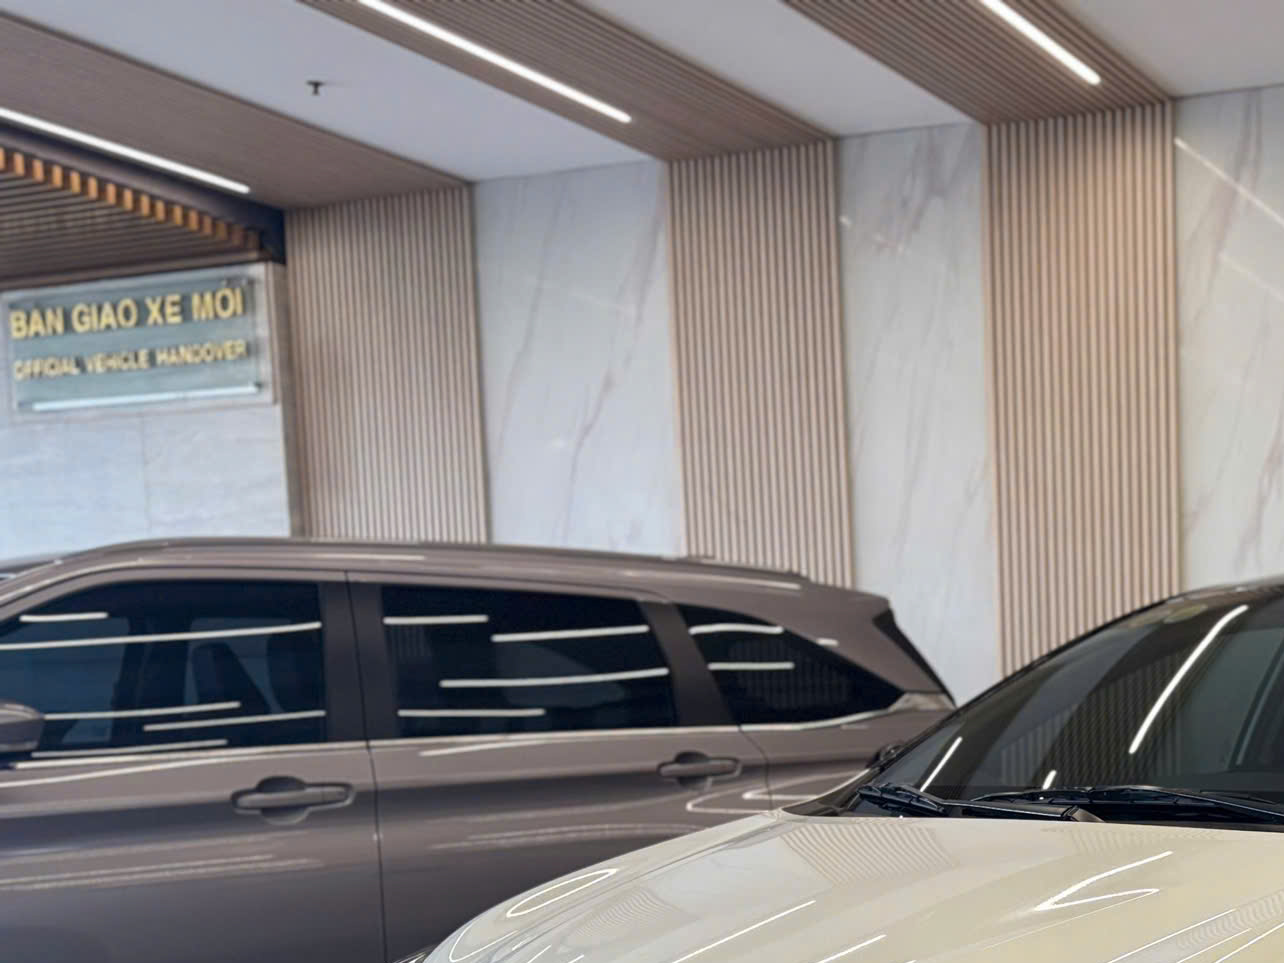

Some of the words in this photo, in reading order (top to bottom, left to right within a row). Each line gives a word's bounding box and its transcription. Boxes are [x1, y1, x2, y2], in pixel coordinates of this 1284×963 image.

[72, 298, 138, 333] GIAO
[145, 293, 182, 326] XE
[87, 347, 150, 373] VEHICLE
[156, 339, 248, 367] HANDOVER
